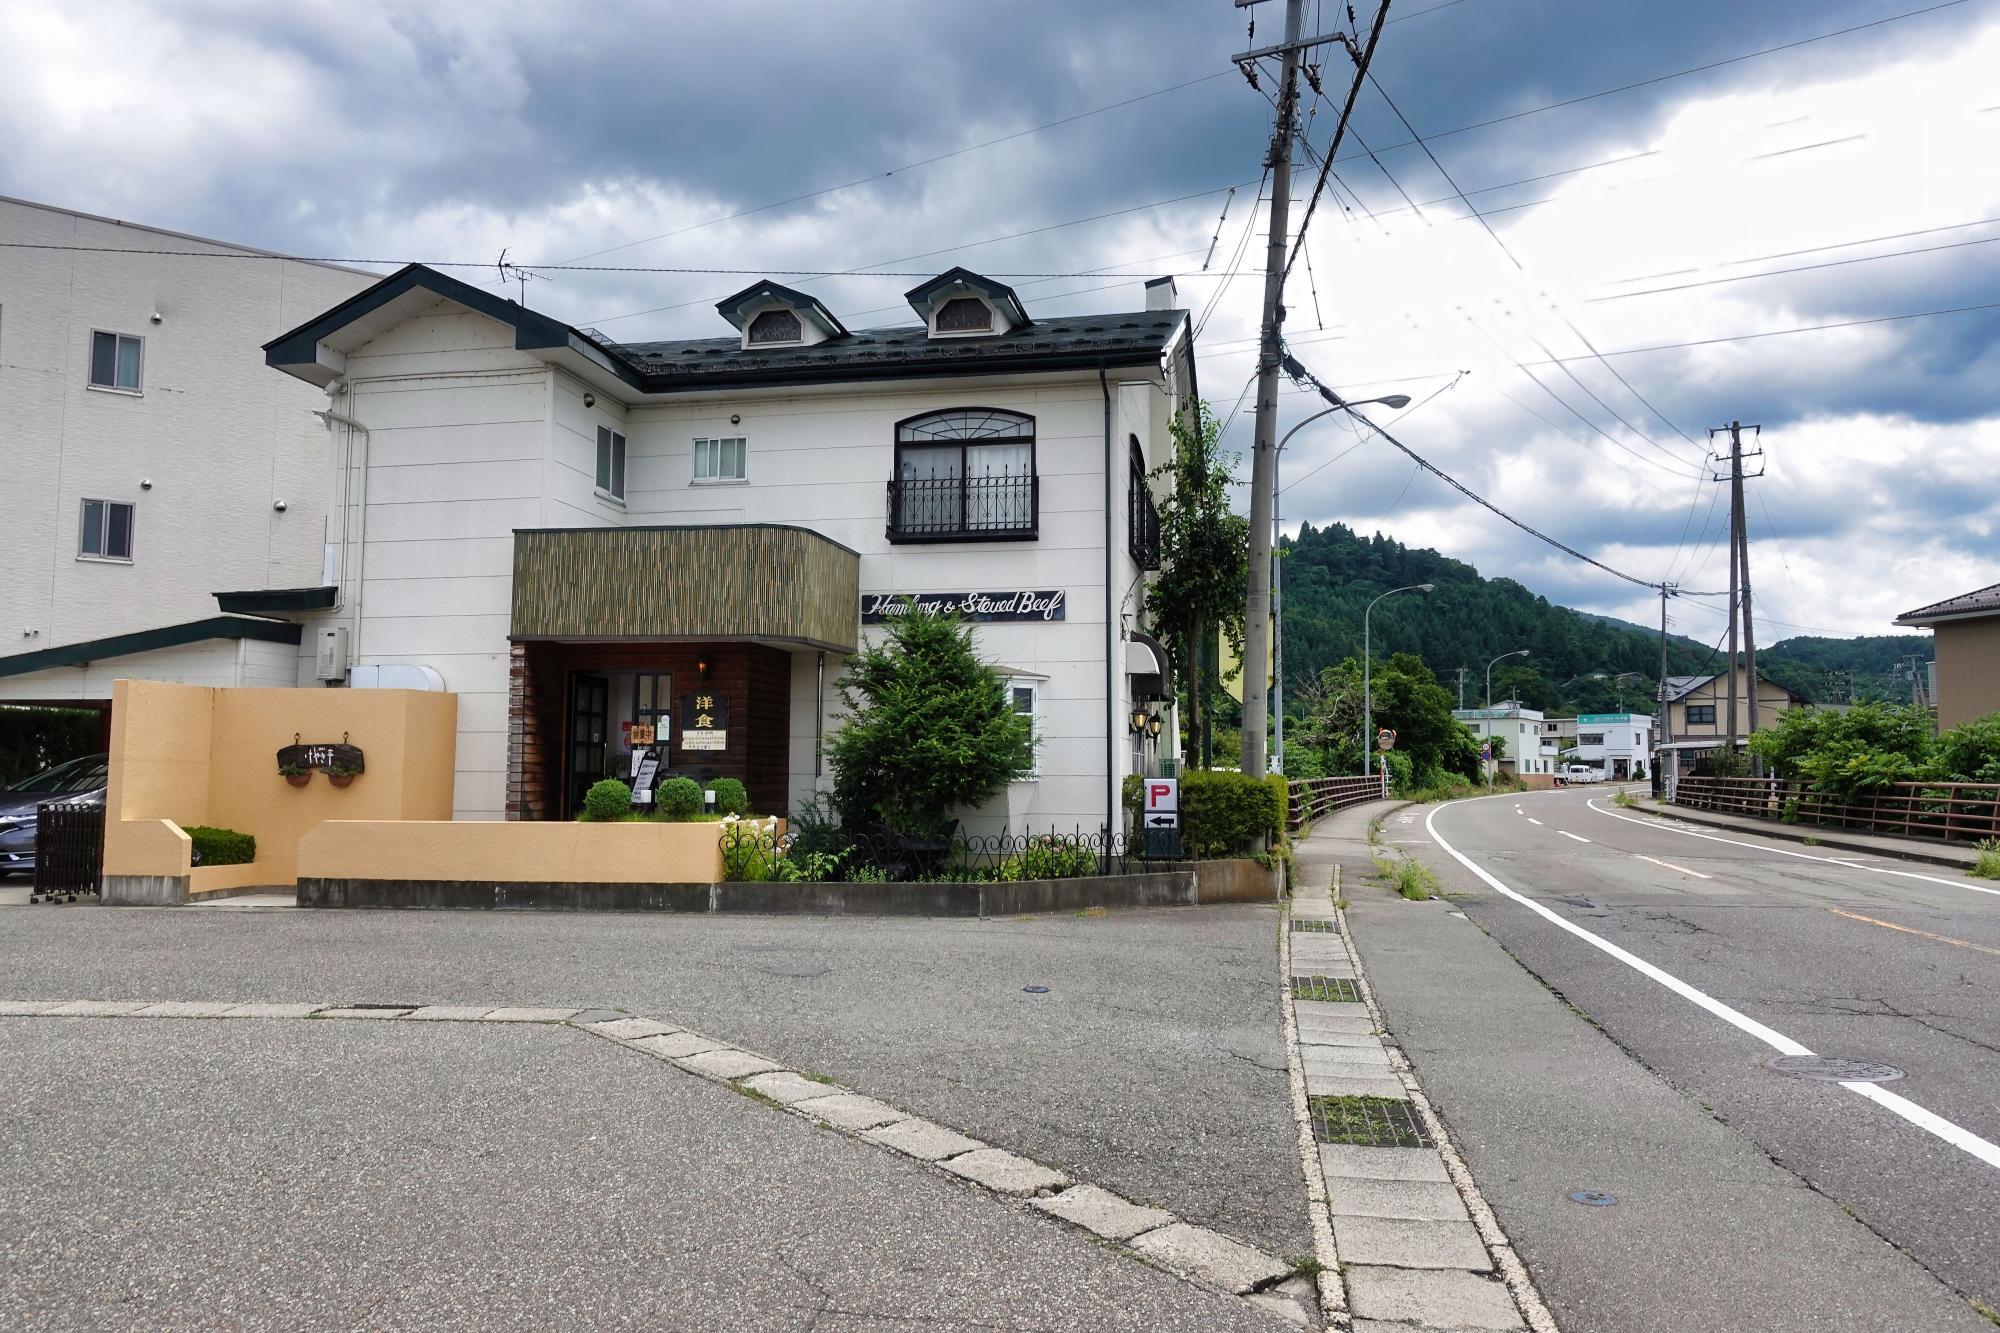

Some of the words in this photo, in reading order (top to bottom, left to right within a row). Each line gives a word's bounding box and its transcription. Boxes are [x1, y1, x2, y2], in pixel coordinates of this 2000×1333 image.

[943, 600, 955, 613] &
[1017, 590, 1065, 620] Beef
[695, 696, 714, 728] 洋食
[1151, 784, 1171, 807] P
